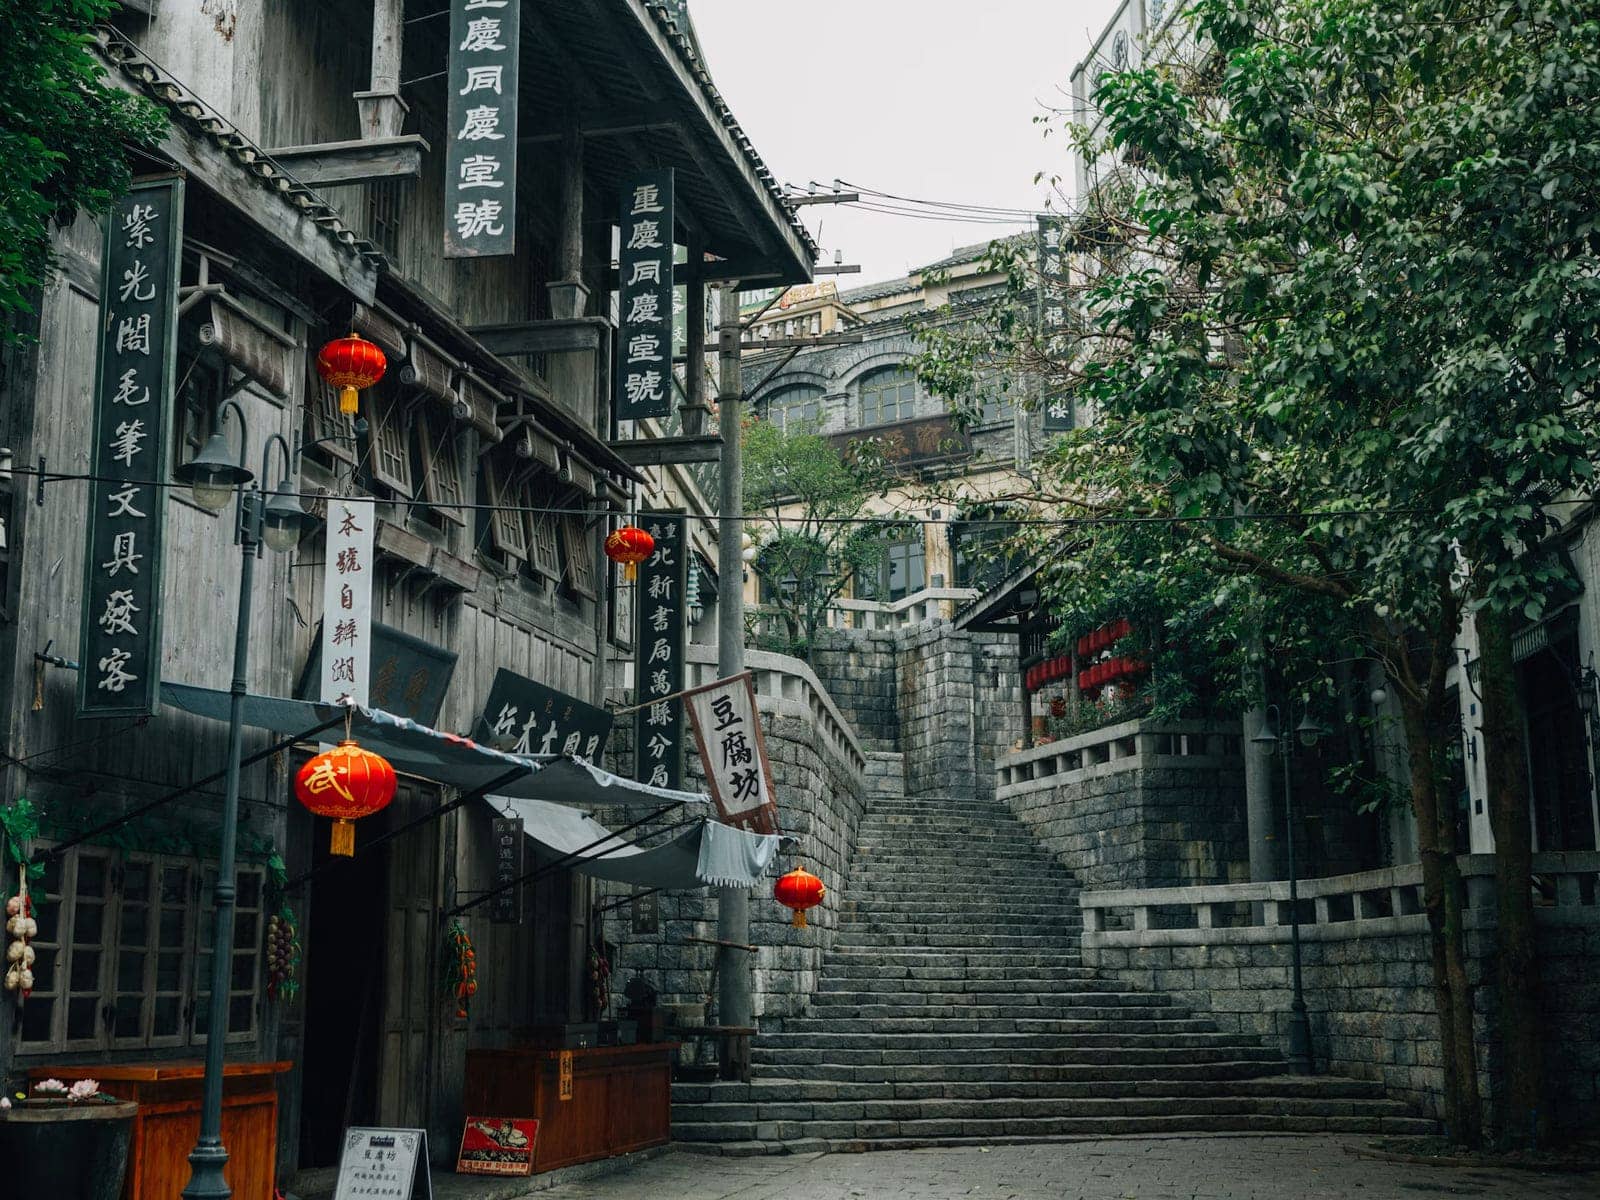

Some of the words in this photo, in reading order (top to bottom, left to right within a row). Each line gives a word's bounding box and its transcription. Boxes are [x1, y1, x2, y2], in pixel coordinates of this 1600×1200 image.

[625, 184, 664, 404] 重慶同慶堂號
[647, 546, 675, 788] 北新書局萬縣分局
[711, 694, 760, 803] 豆腐坊
